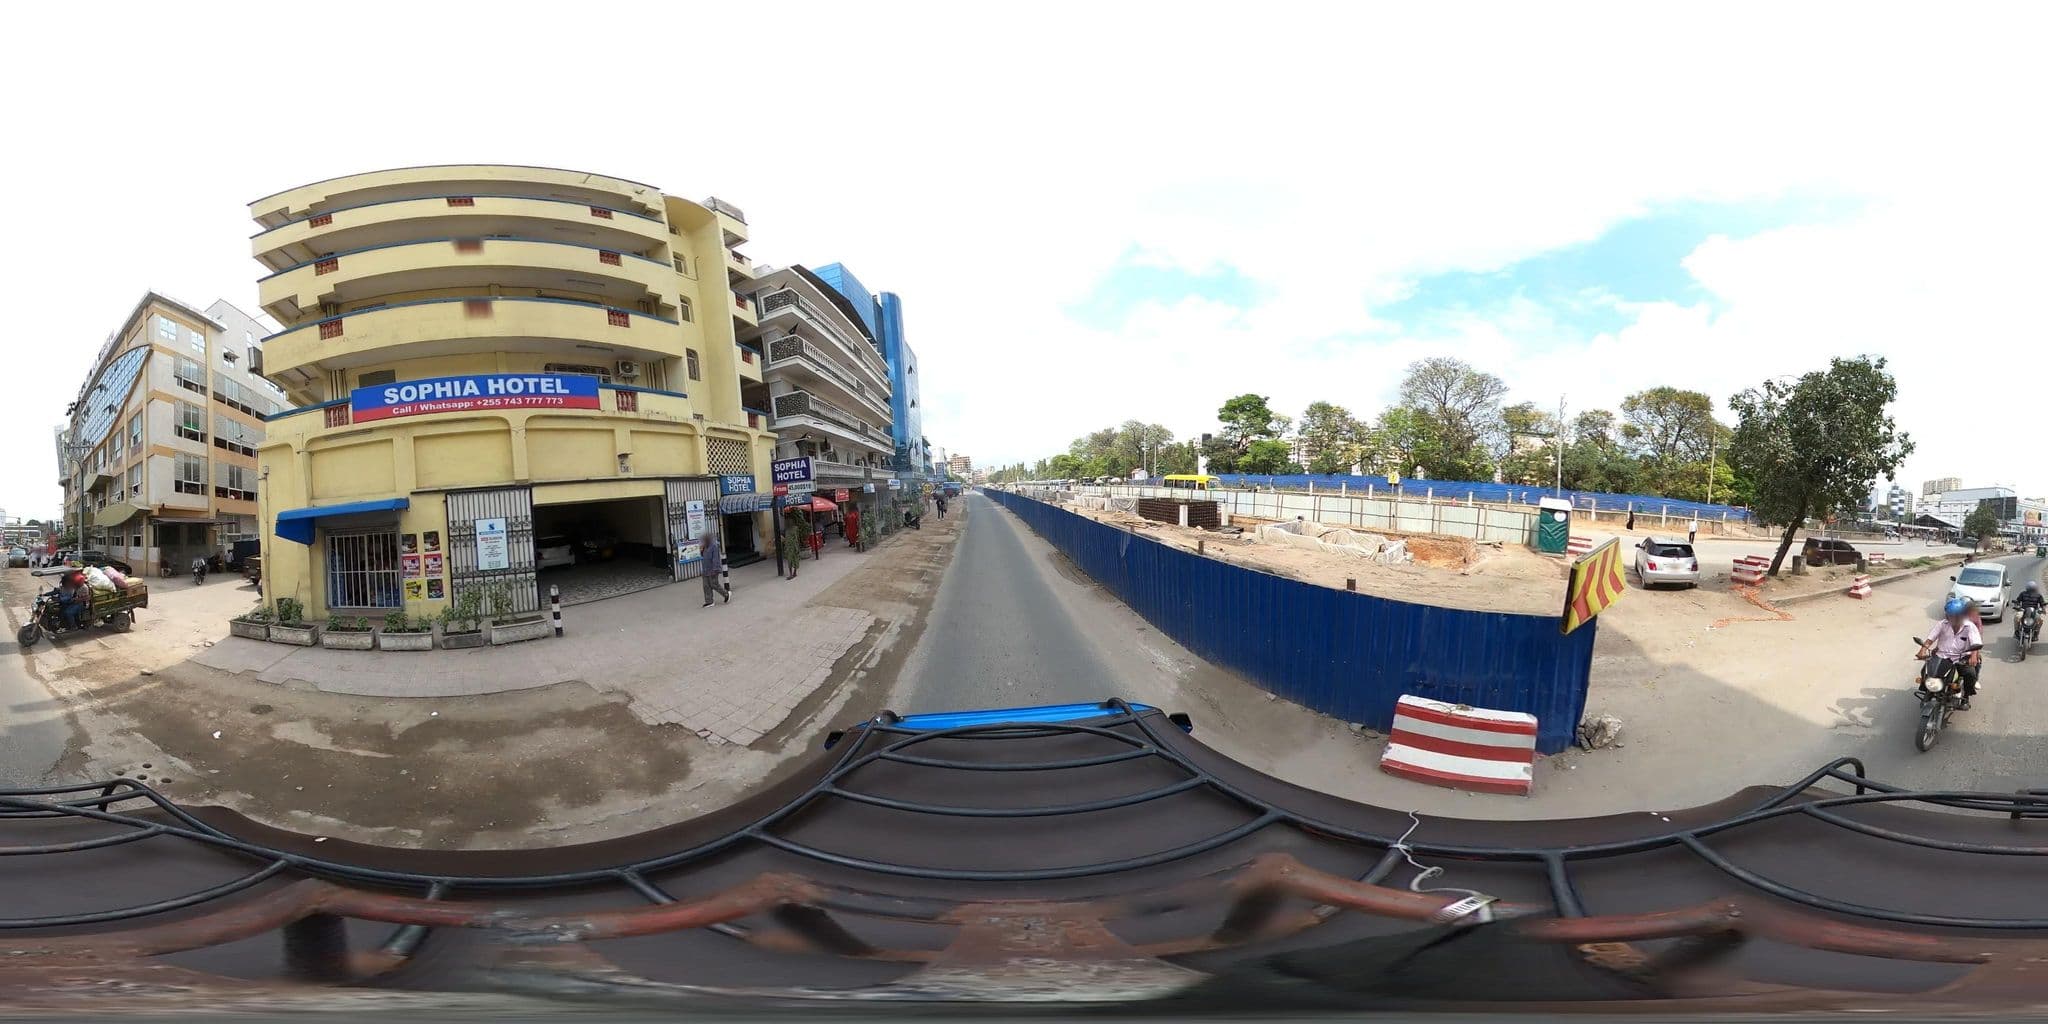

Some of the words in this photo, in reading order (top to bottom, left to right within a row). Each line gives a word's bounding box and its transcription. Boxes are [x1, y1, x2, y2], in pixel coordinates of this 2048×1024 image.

[384, 377, 480, 404] SOPHIA
[488, 377, 570, 395] HOTEL
[393, 405, 412, 415] Call
[420, 401, 474, 412] Whatsapp:
[476, 398, 501, 406] +255
[504, 397, 522, 405] 743
[546, 397, 563, 405] 773
[774, 460, 807, 472] SOPHIA
[727, 476, 752, 484] SOPHIA
[777, 471, 806, 480] HOTEL
[785, 497, 805, 505] HOTEL
